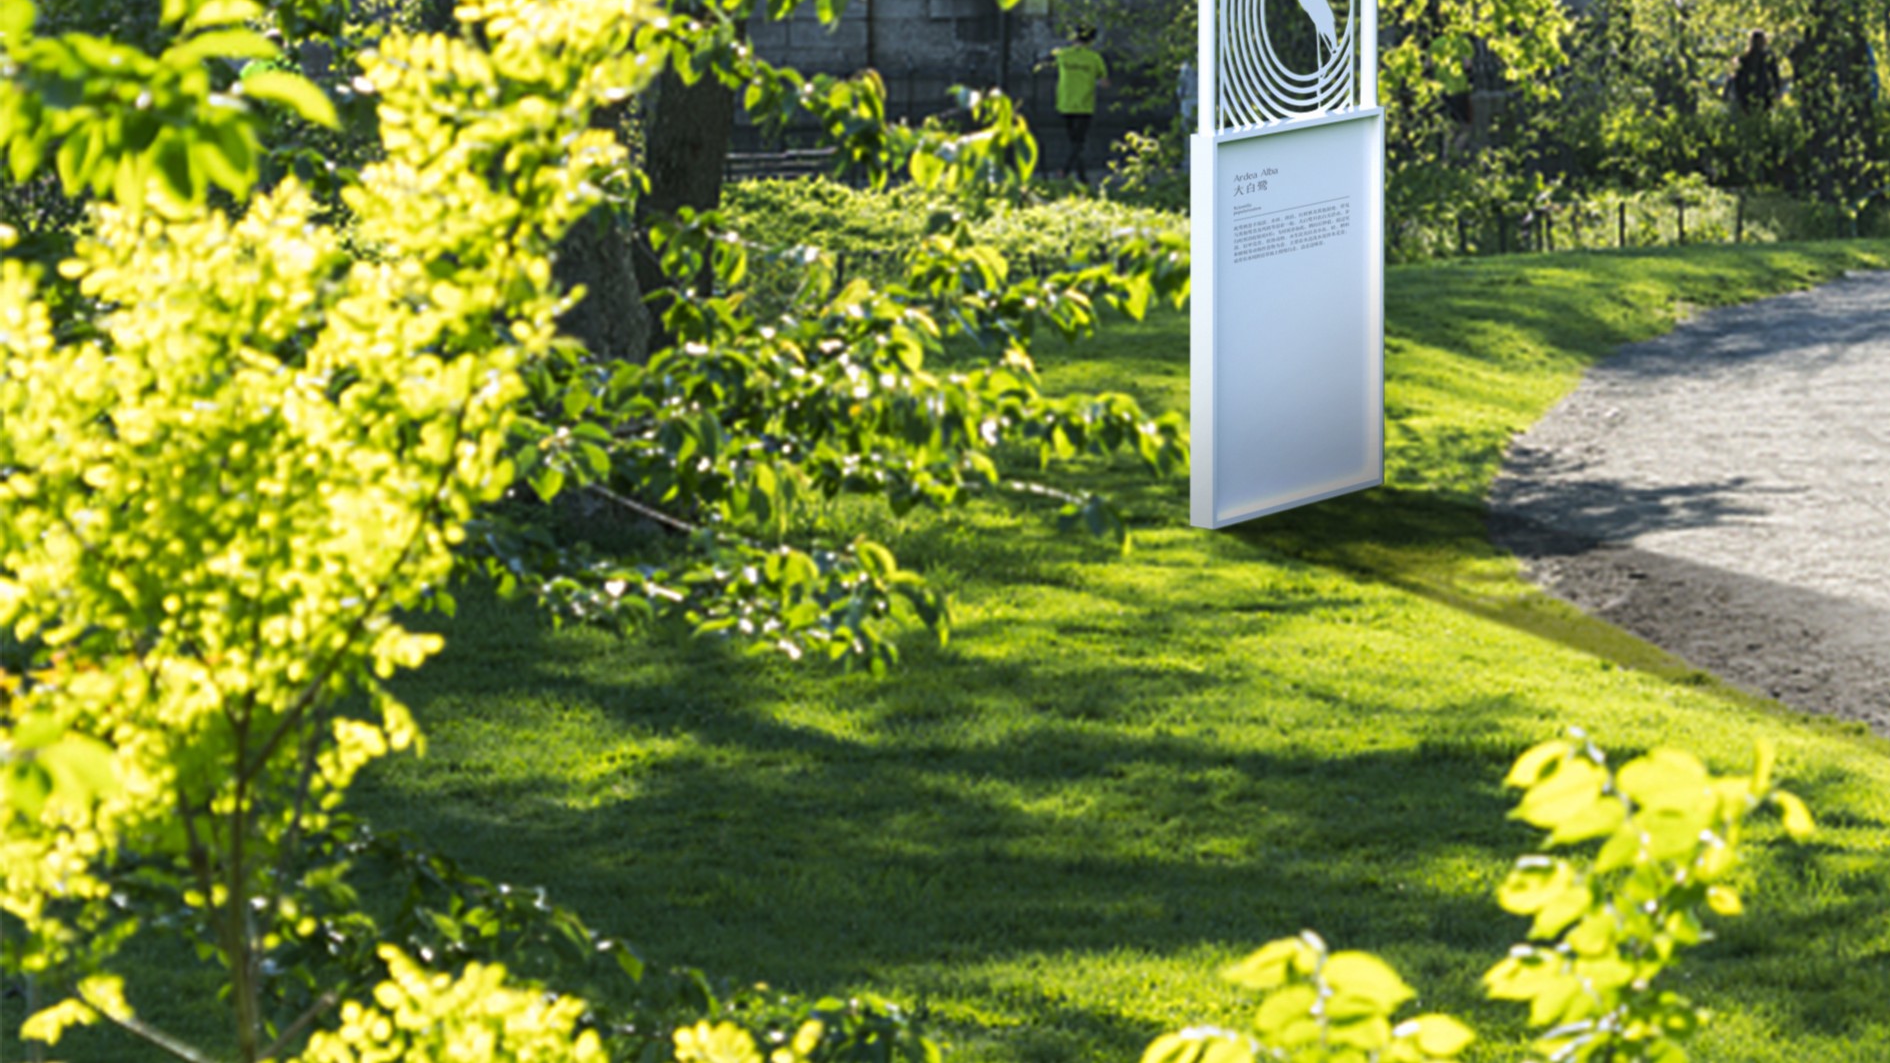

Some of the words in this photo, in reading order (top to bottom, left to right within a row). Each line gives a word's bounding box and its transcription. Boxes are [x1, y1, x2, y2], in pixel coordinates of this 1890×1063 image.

[1233, 172, 1258, 183] Ardea
[1260, 167, 1279, 177] Alba
[1233, 179, 1268, 197] 大白鹭
